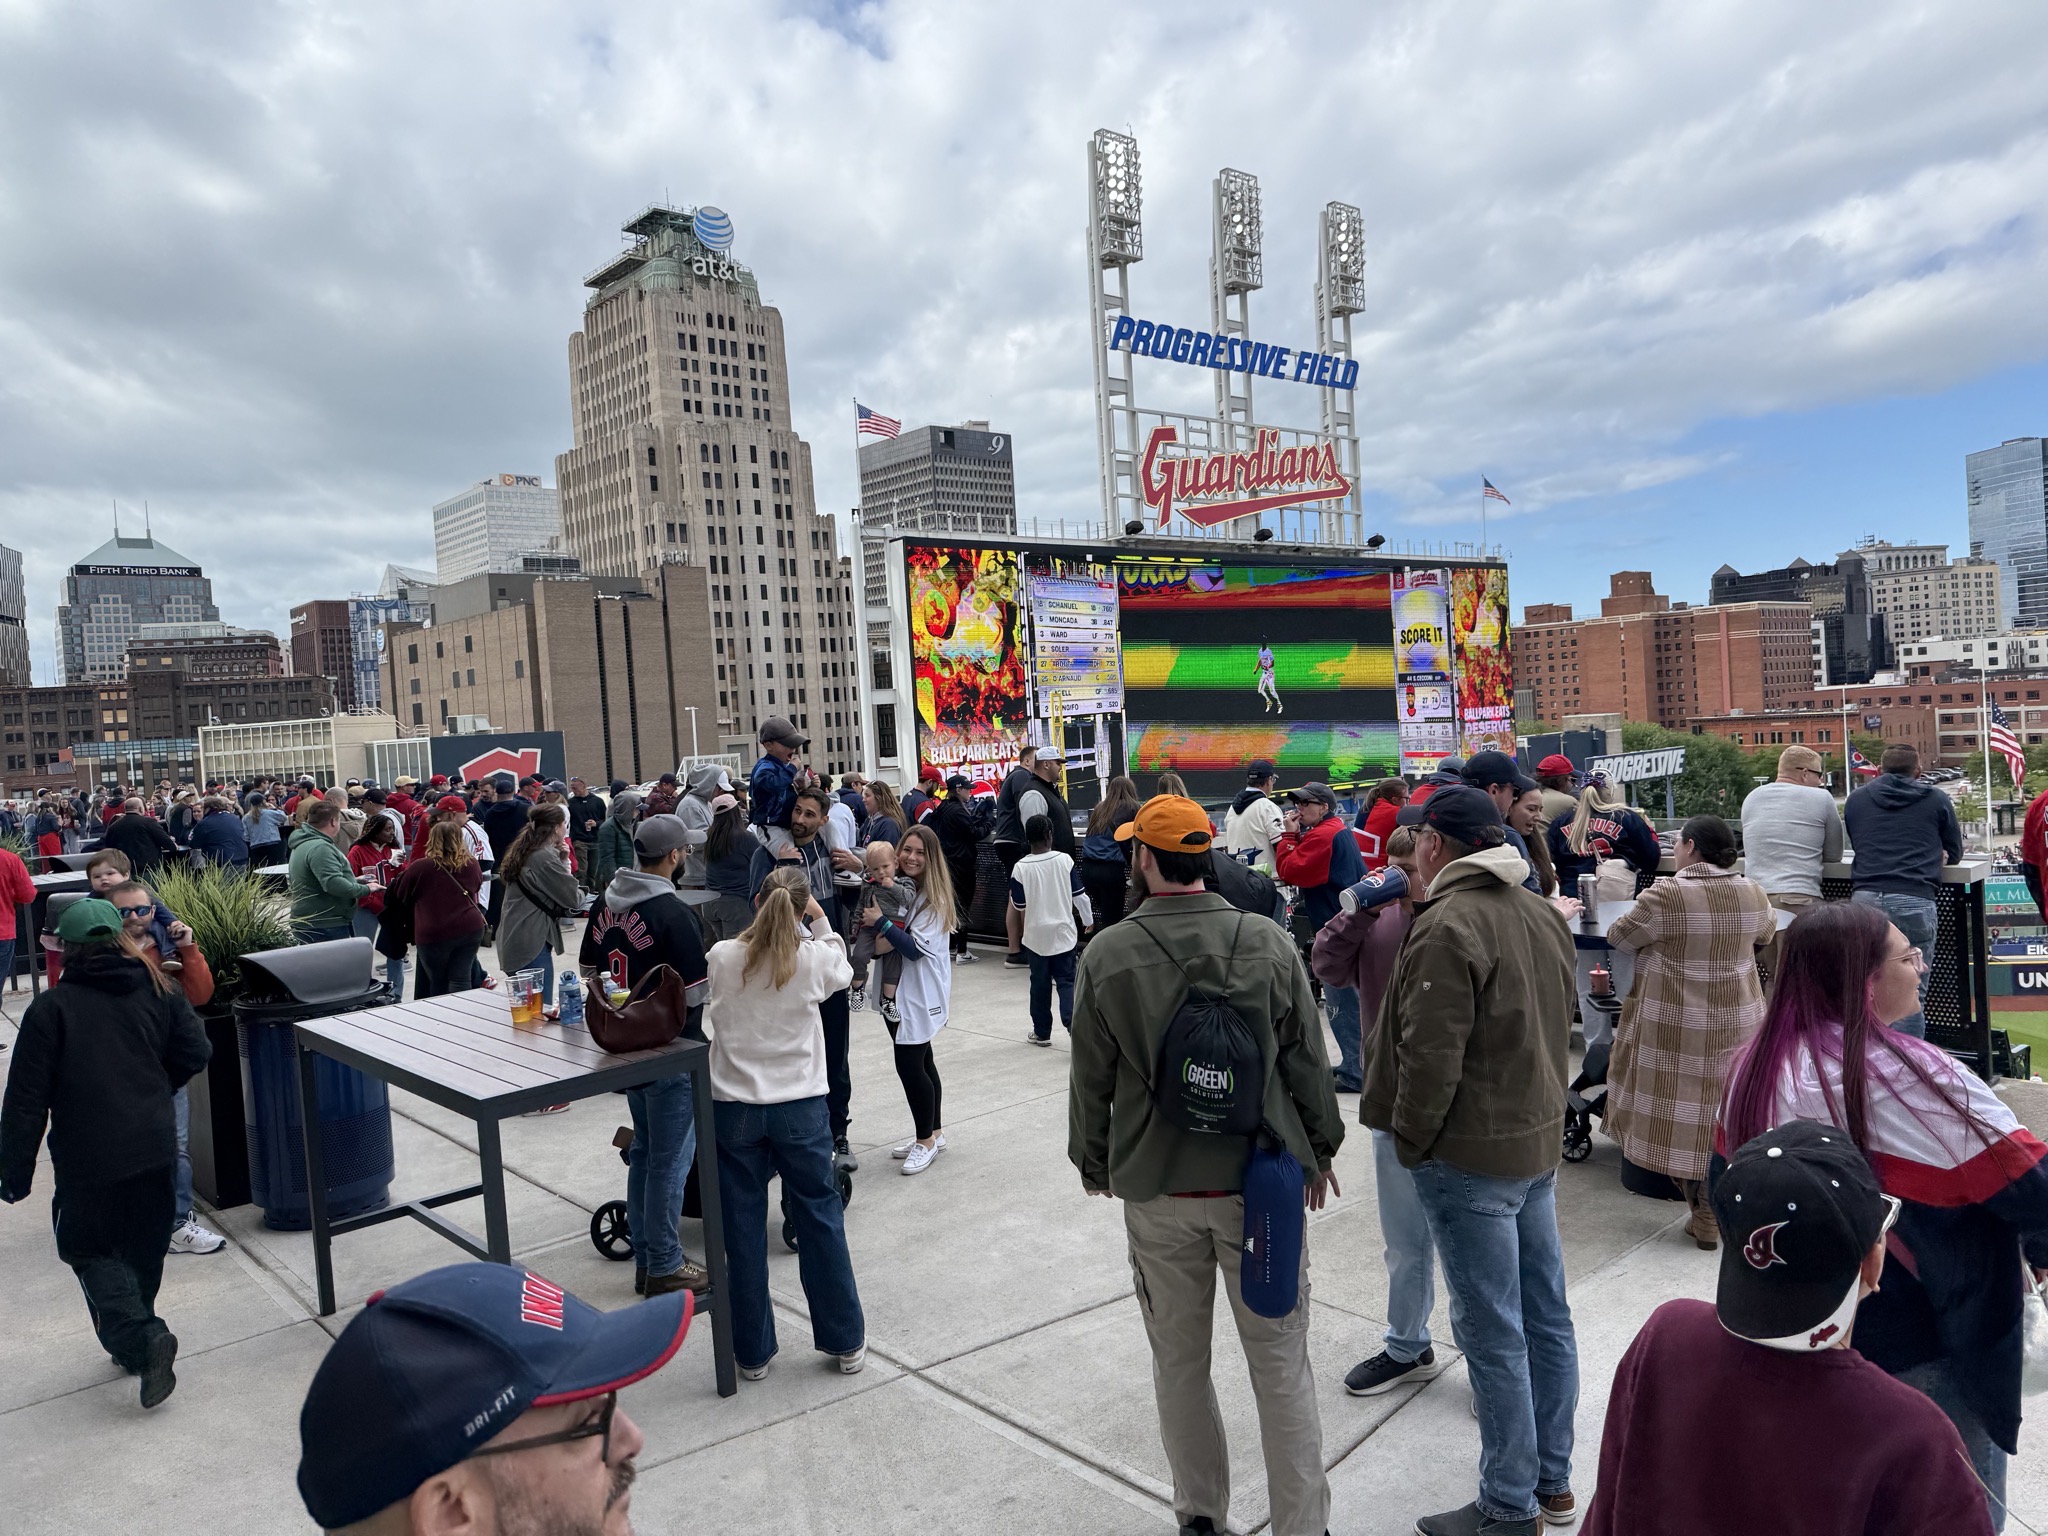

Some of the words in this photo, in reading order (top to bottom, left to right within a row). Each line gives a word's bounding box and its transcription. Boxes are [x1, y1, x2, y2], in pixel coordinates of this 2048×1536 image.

[692, 254, 743, 283] at&t
[1110, 315, 1290, 379] PROGRESSIVE
[1294, 350, 1359, 390] FIELD
[991, 435, 1004, 455] 9
[515, 476, 539, 487] PNC
[1140, 425, 1351, 530] Guardians
[89, 566, 120, 575] FIFTH
[122, 566, 158, 575] THIRD
[160, 567, 190, 576] BANK
[1048, 601, 1078, 610] SCHANUEL
[1049, 616, 1078, 624] MONCADA
[1400, 627, 1432, 645] SCORE
[1433, 626, 1443, 642] IT
[1051, 645, 1070, 653] SOLER
[1463, 706, 1495, 721] BALLPARK
[1495, 705, 1510, 719] EATS
[1465, 719, 1511, 735] DESERVE
[930, 743, 993, 765] BALLPARK
[993, 741, 1020, 760] EATS
[1481, 743, 1498, 751] PEPSI
[1592, 749, 1685, 784] PROGRESSIVE
[2018, 972, 2048, 988] UN
[1187, 1064, 1227, 1090] GREEN
[1190, 1086, 1224, 1099] SOLUTION
[464, 1385, 515, 1437] DRI-FIT
